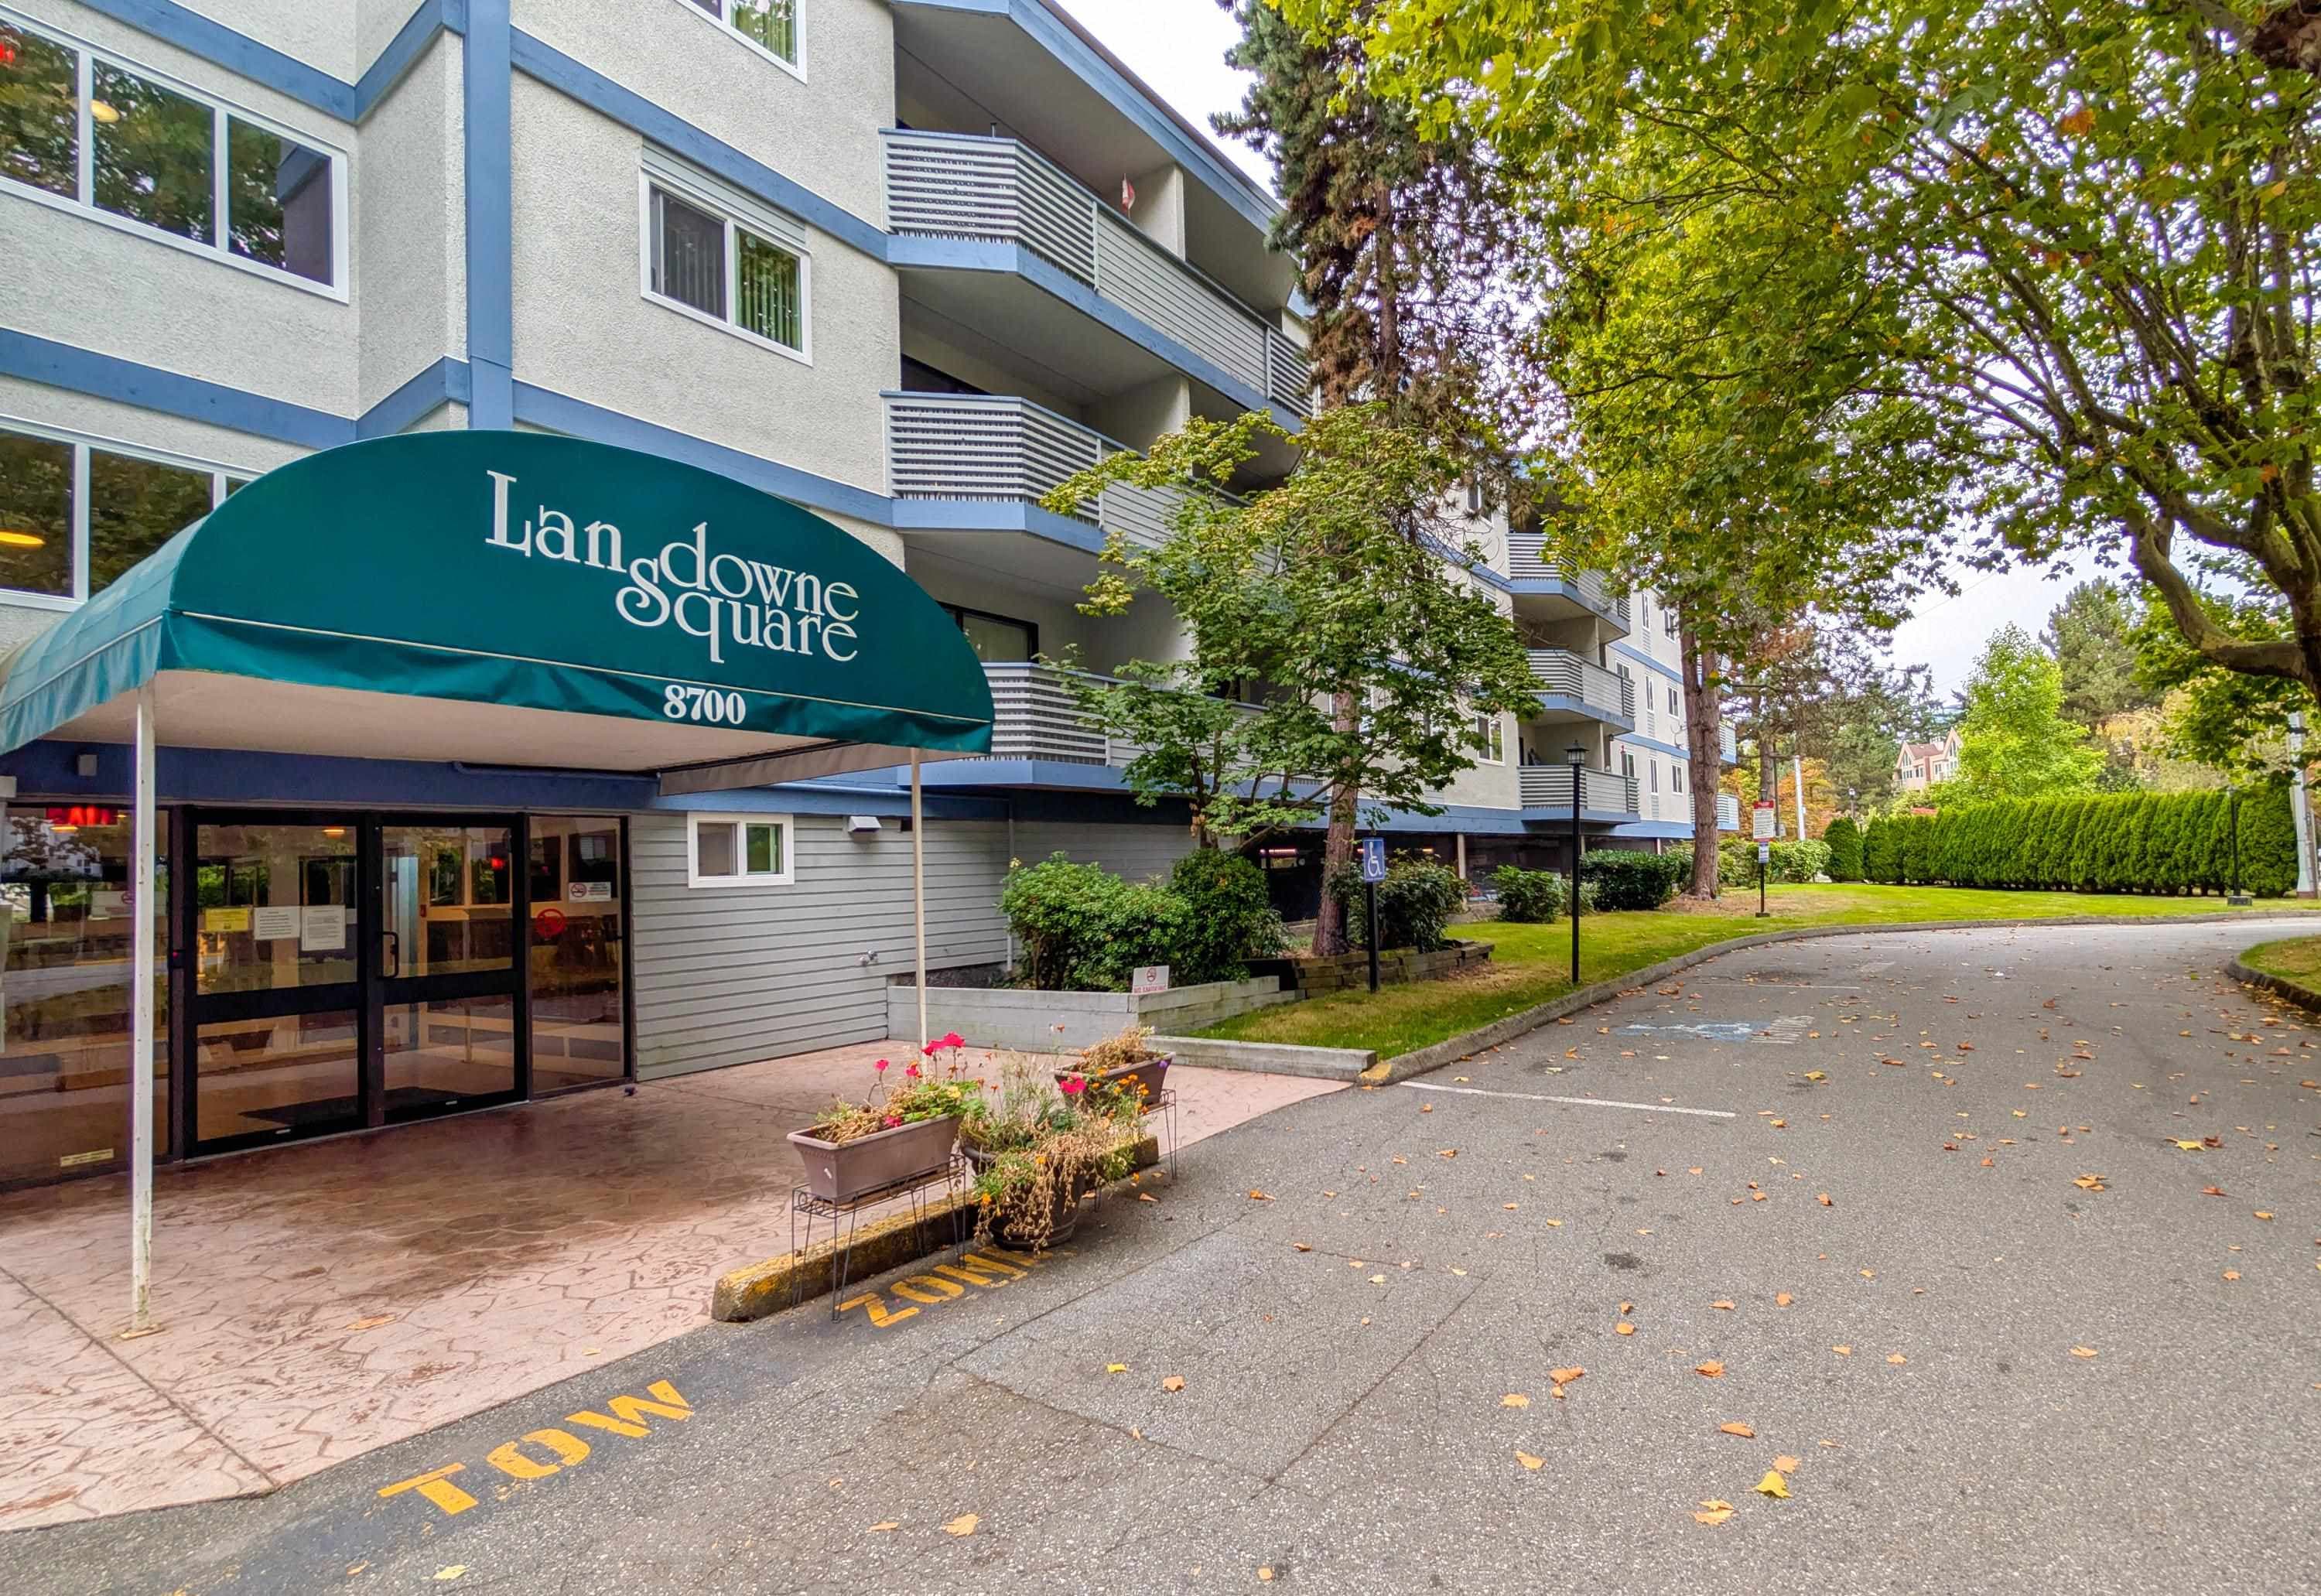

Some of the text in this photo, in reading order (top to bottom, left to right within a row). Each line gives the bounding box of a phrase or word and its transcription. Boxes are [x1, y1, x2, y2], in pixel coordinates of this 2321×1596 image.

[486, 470, 859, 626] Lansdowne
[616, 558, 859, 663] Square
[663, 684, 747, 725] 8700
[376, 1379, 695, 1516] TOW
